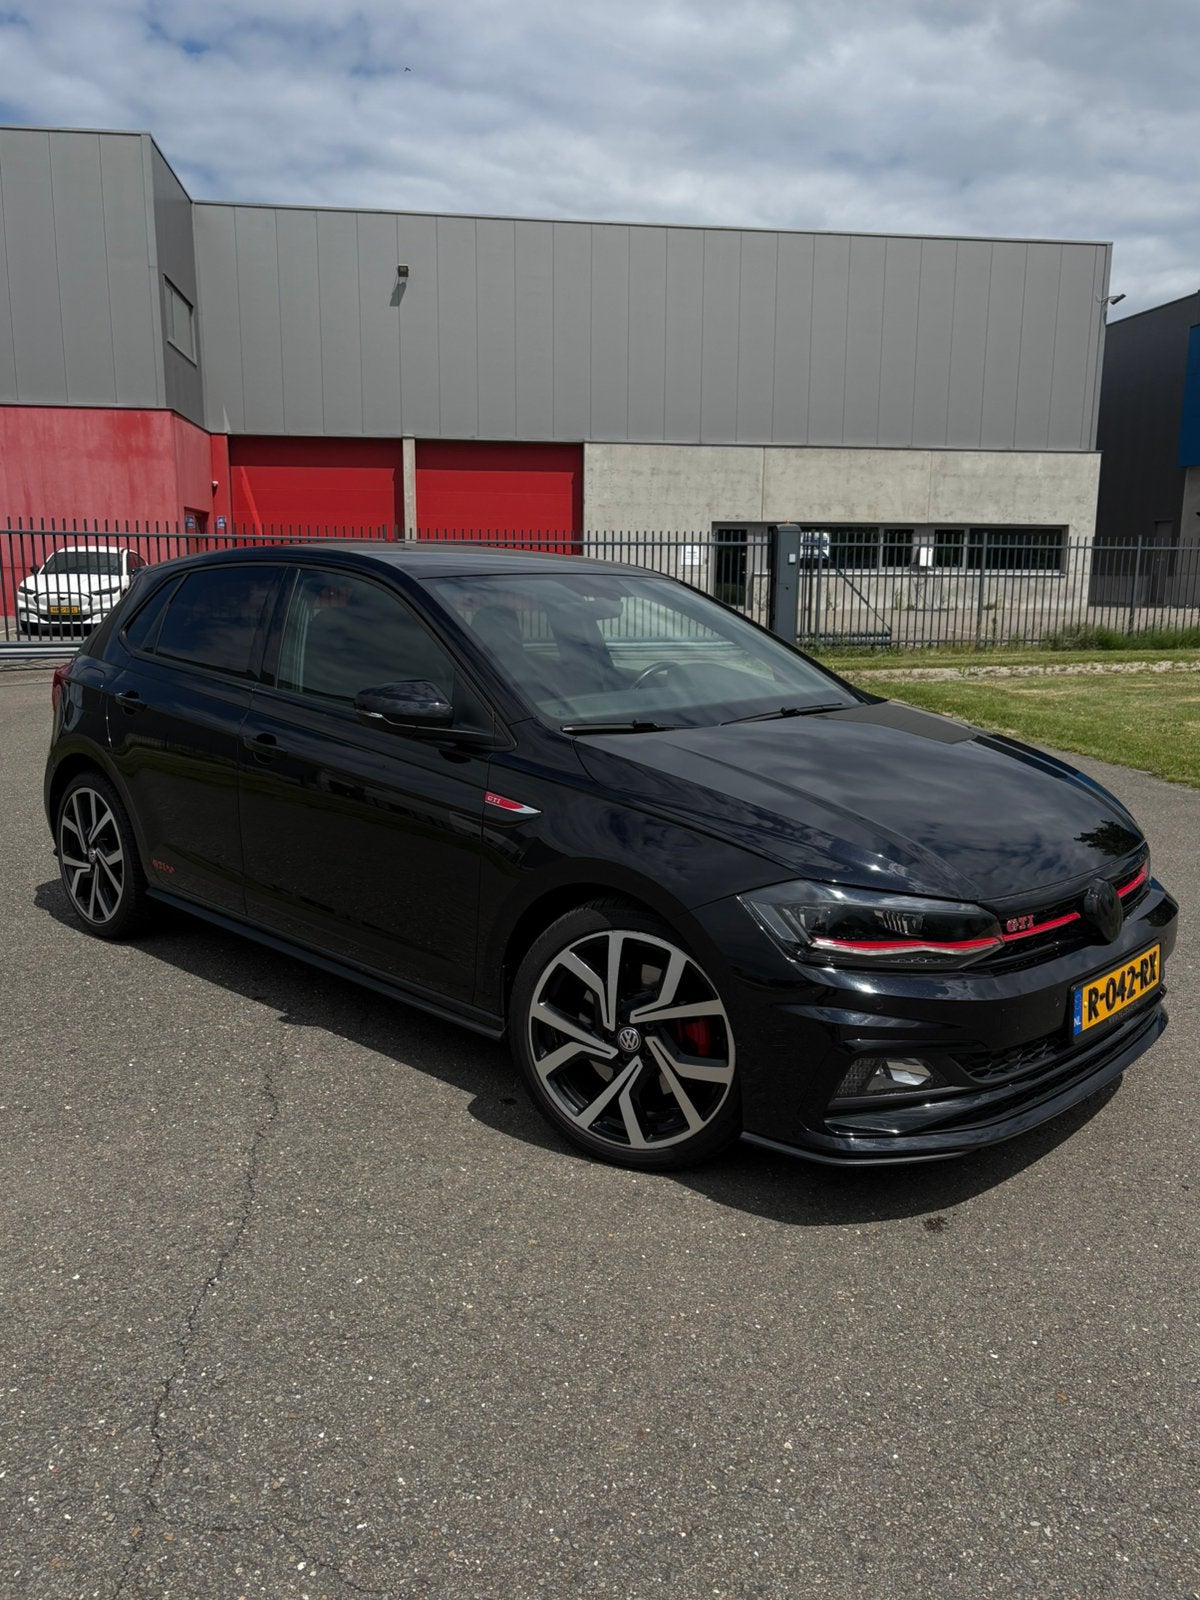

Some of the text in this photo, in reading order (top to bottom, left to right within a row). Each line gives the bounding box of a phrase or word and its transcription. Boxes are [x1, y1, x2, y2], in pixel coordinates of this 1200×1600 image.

[487, 795, 501, 804] GTI
[1006, 914, 1035, 933] GTI
[1087, 950, 1158, 1023] R-042-RX
